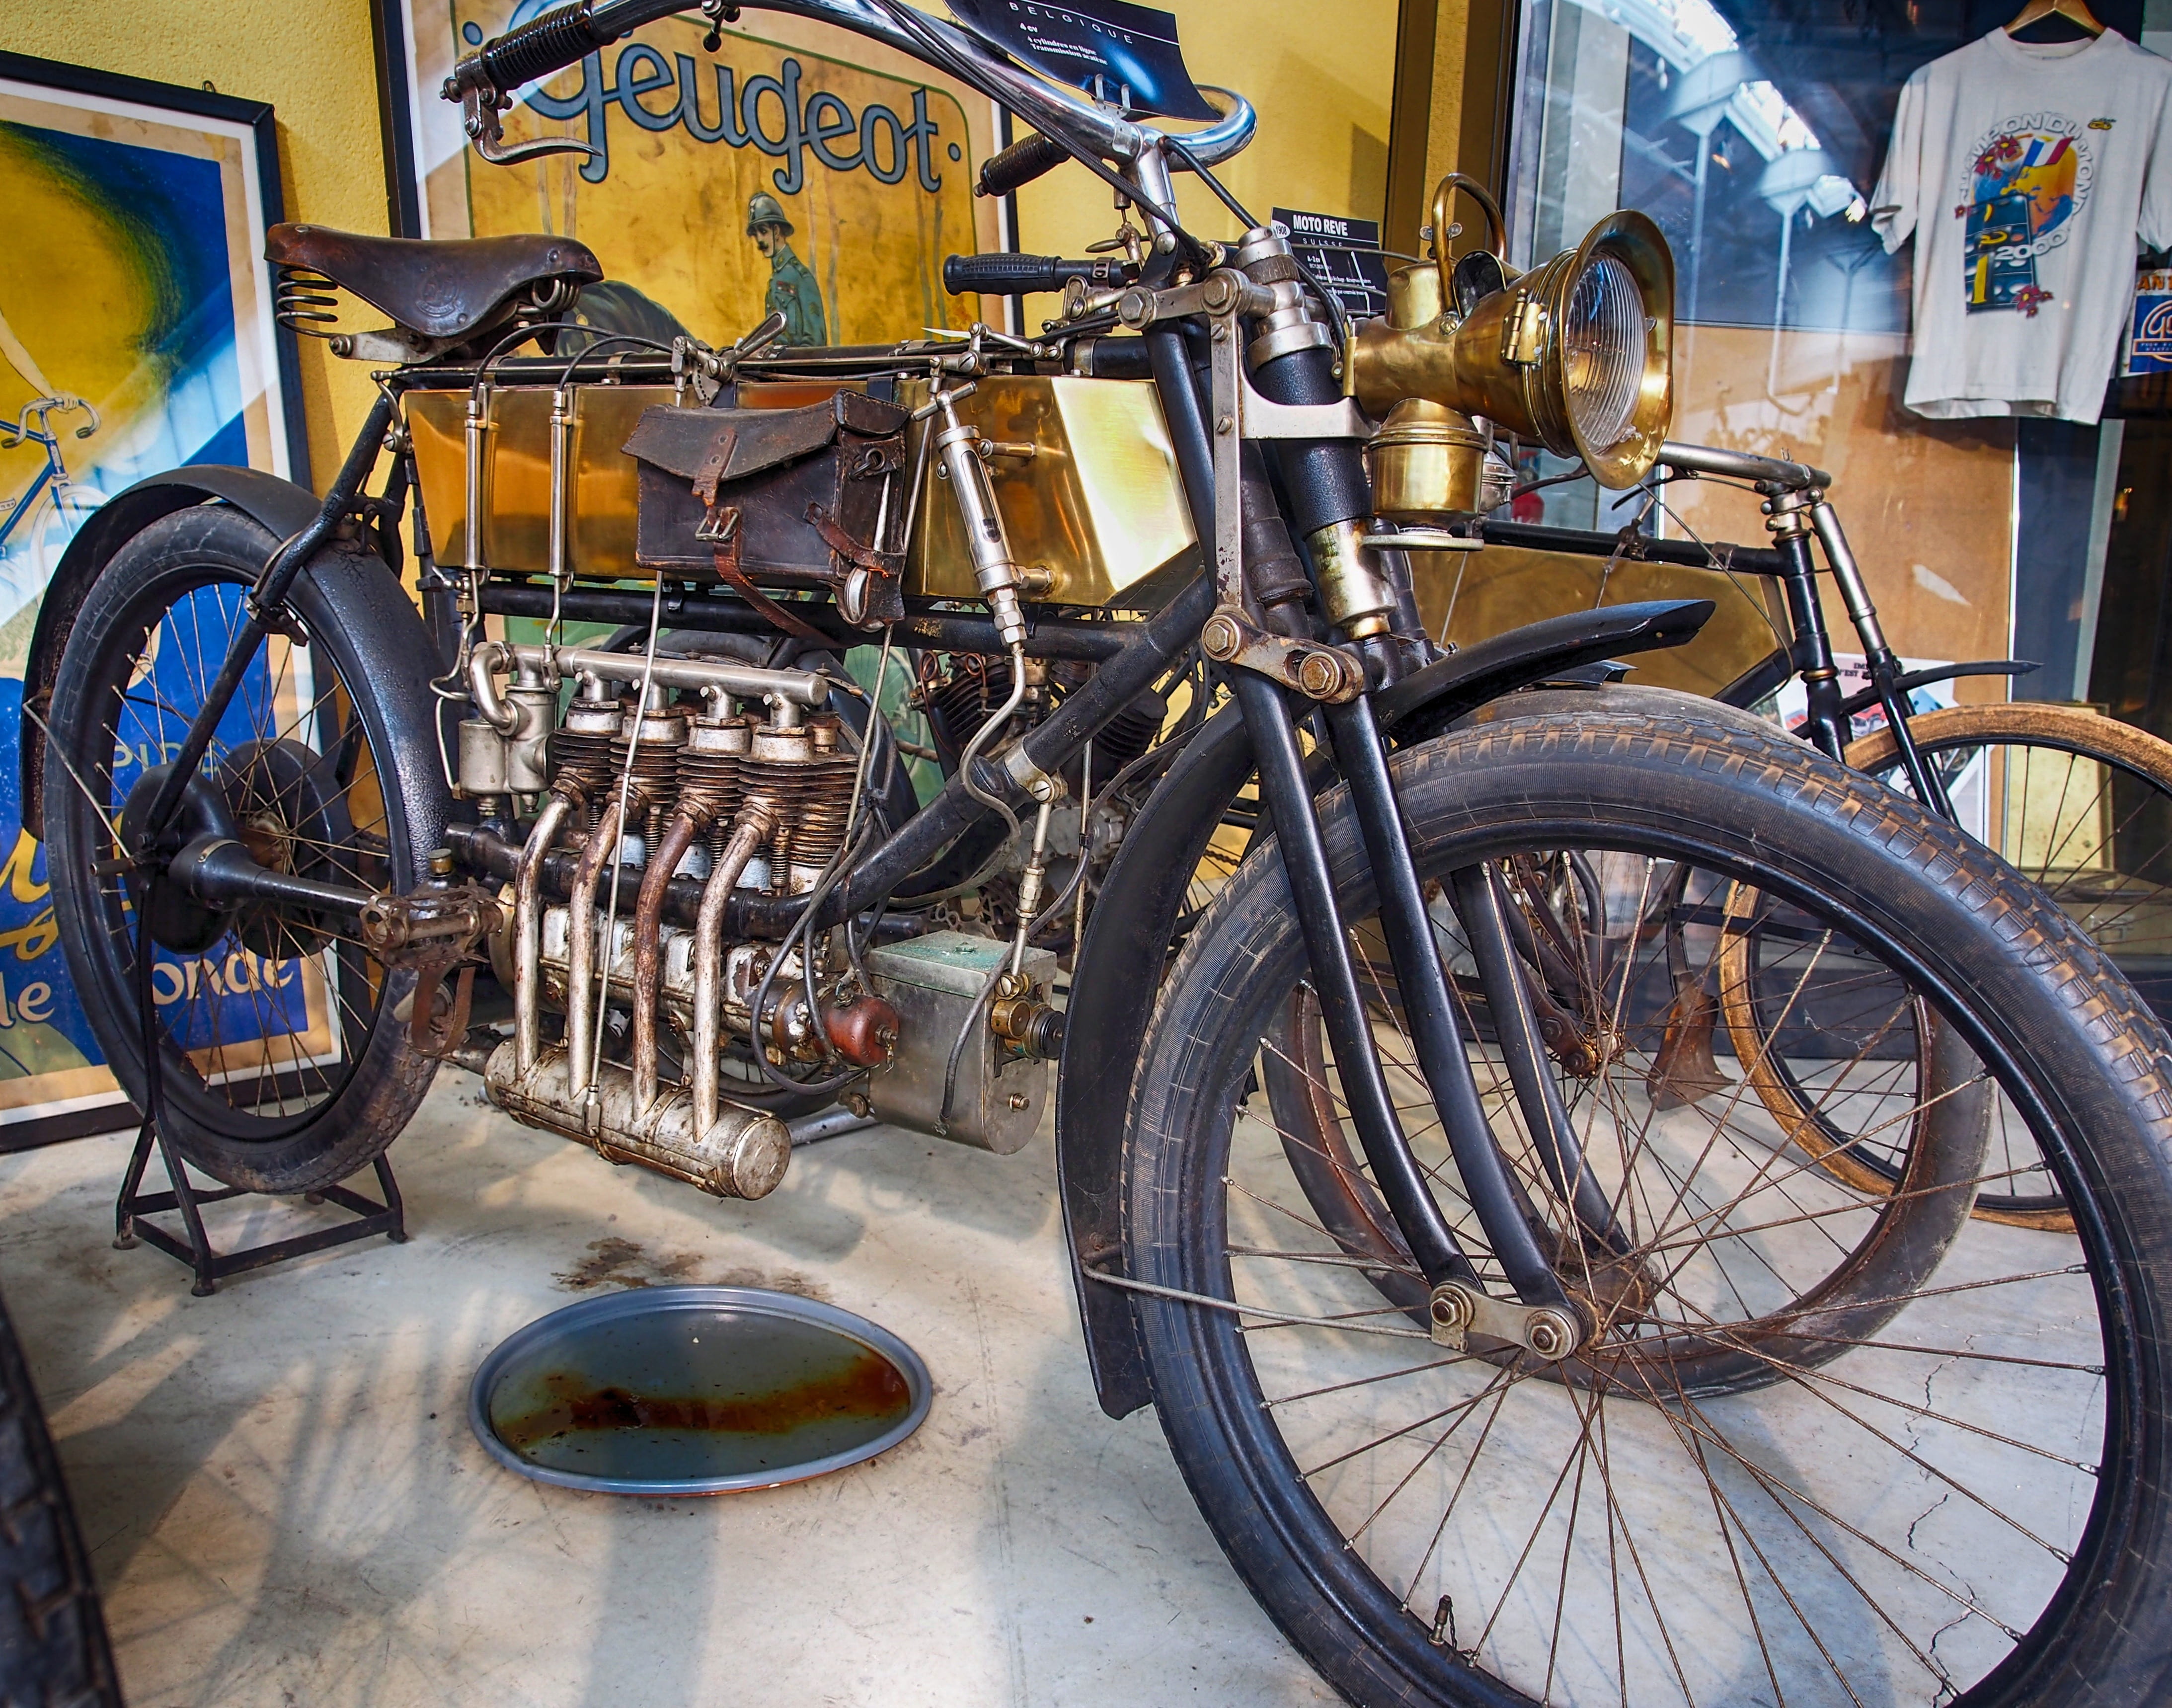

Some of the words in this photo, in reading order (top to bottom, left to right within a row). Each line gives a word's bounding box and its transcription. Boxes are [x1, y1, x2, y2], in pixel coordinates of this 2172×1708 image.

[1009, 2, 1133, 44] BELGIQUE
[1030, 43, 1082, 58] Transmission
[1033, 37, 1069, 49] cylindres
[1079, 45, 1097, 56] ligne
[2044, 113, 2083, 140] DU
[1276, 225, 1287, 235] 1908
[1293, 215, 1321, 232] MOTO
[1323, 219, 1348, 236] REVE
[1303, 237, 1342, 247] SUISSE
[1994, 229, 2069, 260] 2000
[153, 946, 295, 1006] onde
